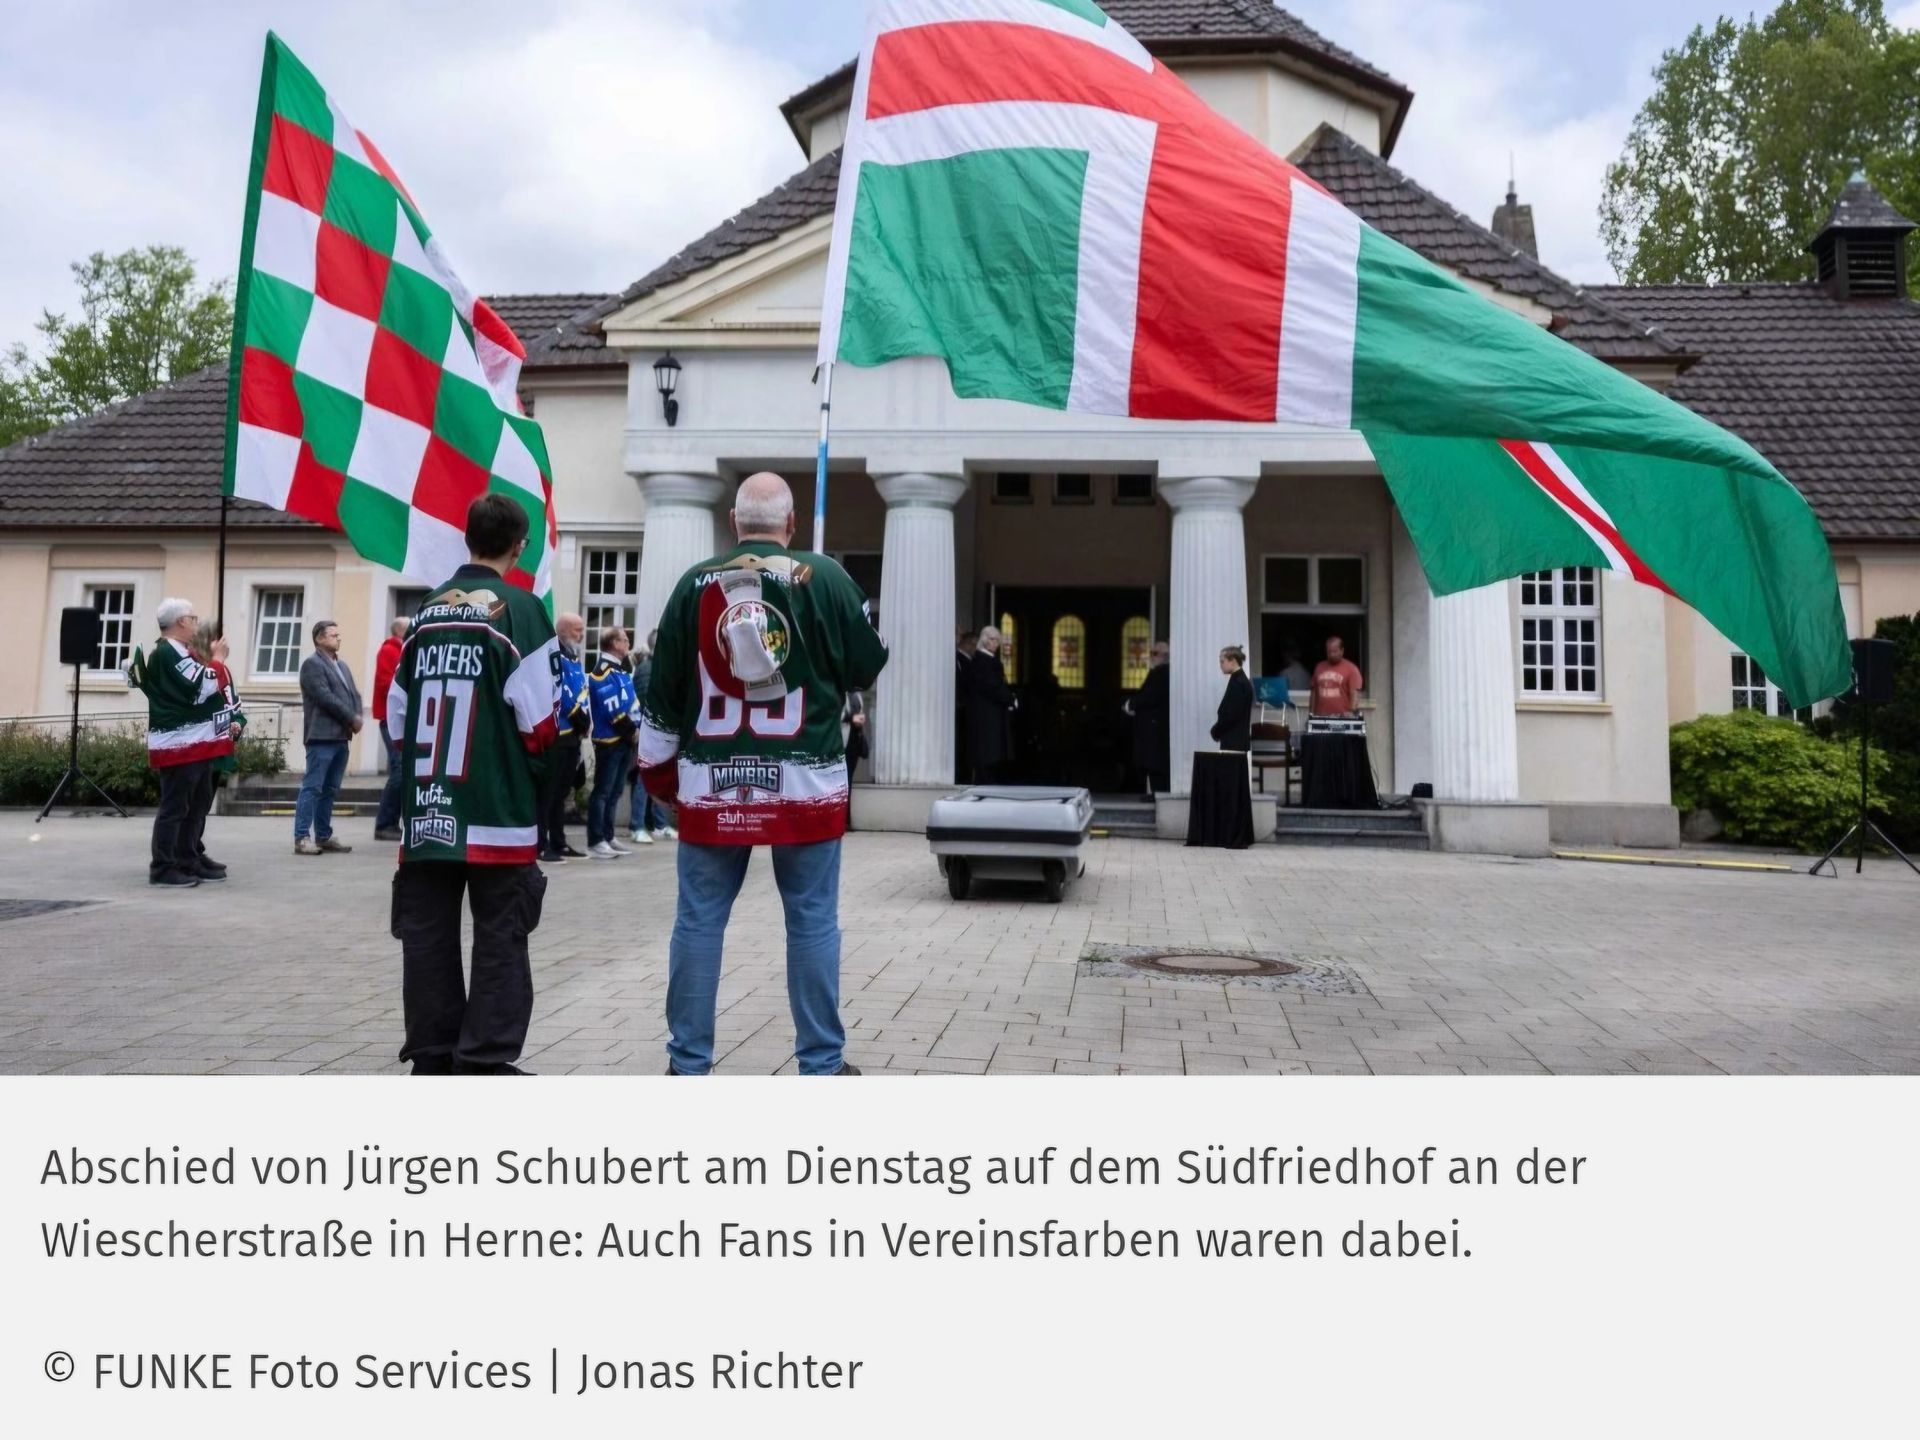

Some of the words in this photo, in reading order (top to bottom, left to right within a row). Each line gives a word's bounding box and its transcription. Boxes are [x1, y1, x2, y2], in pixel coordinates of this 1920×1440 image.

[414, 644, 483, 679] ACKERS
[414, 680, 476, 780] 97
[713, 767, 778, 793] MINERS
